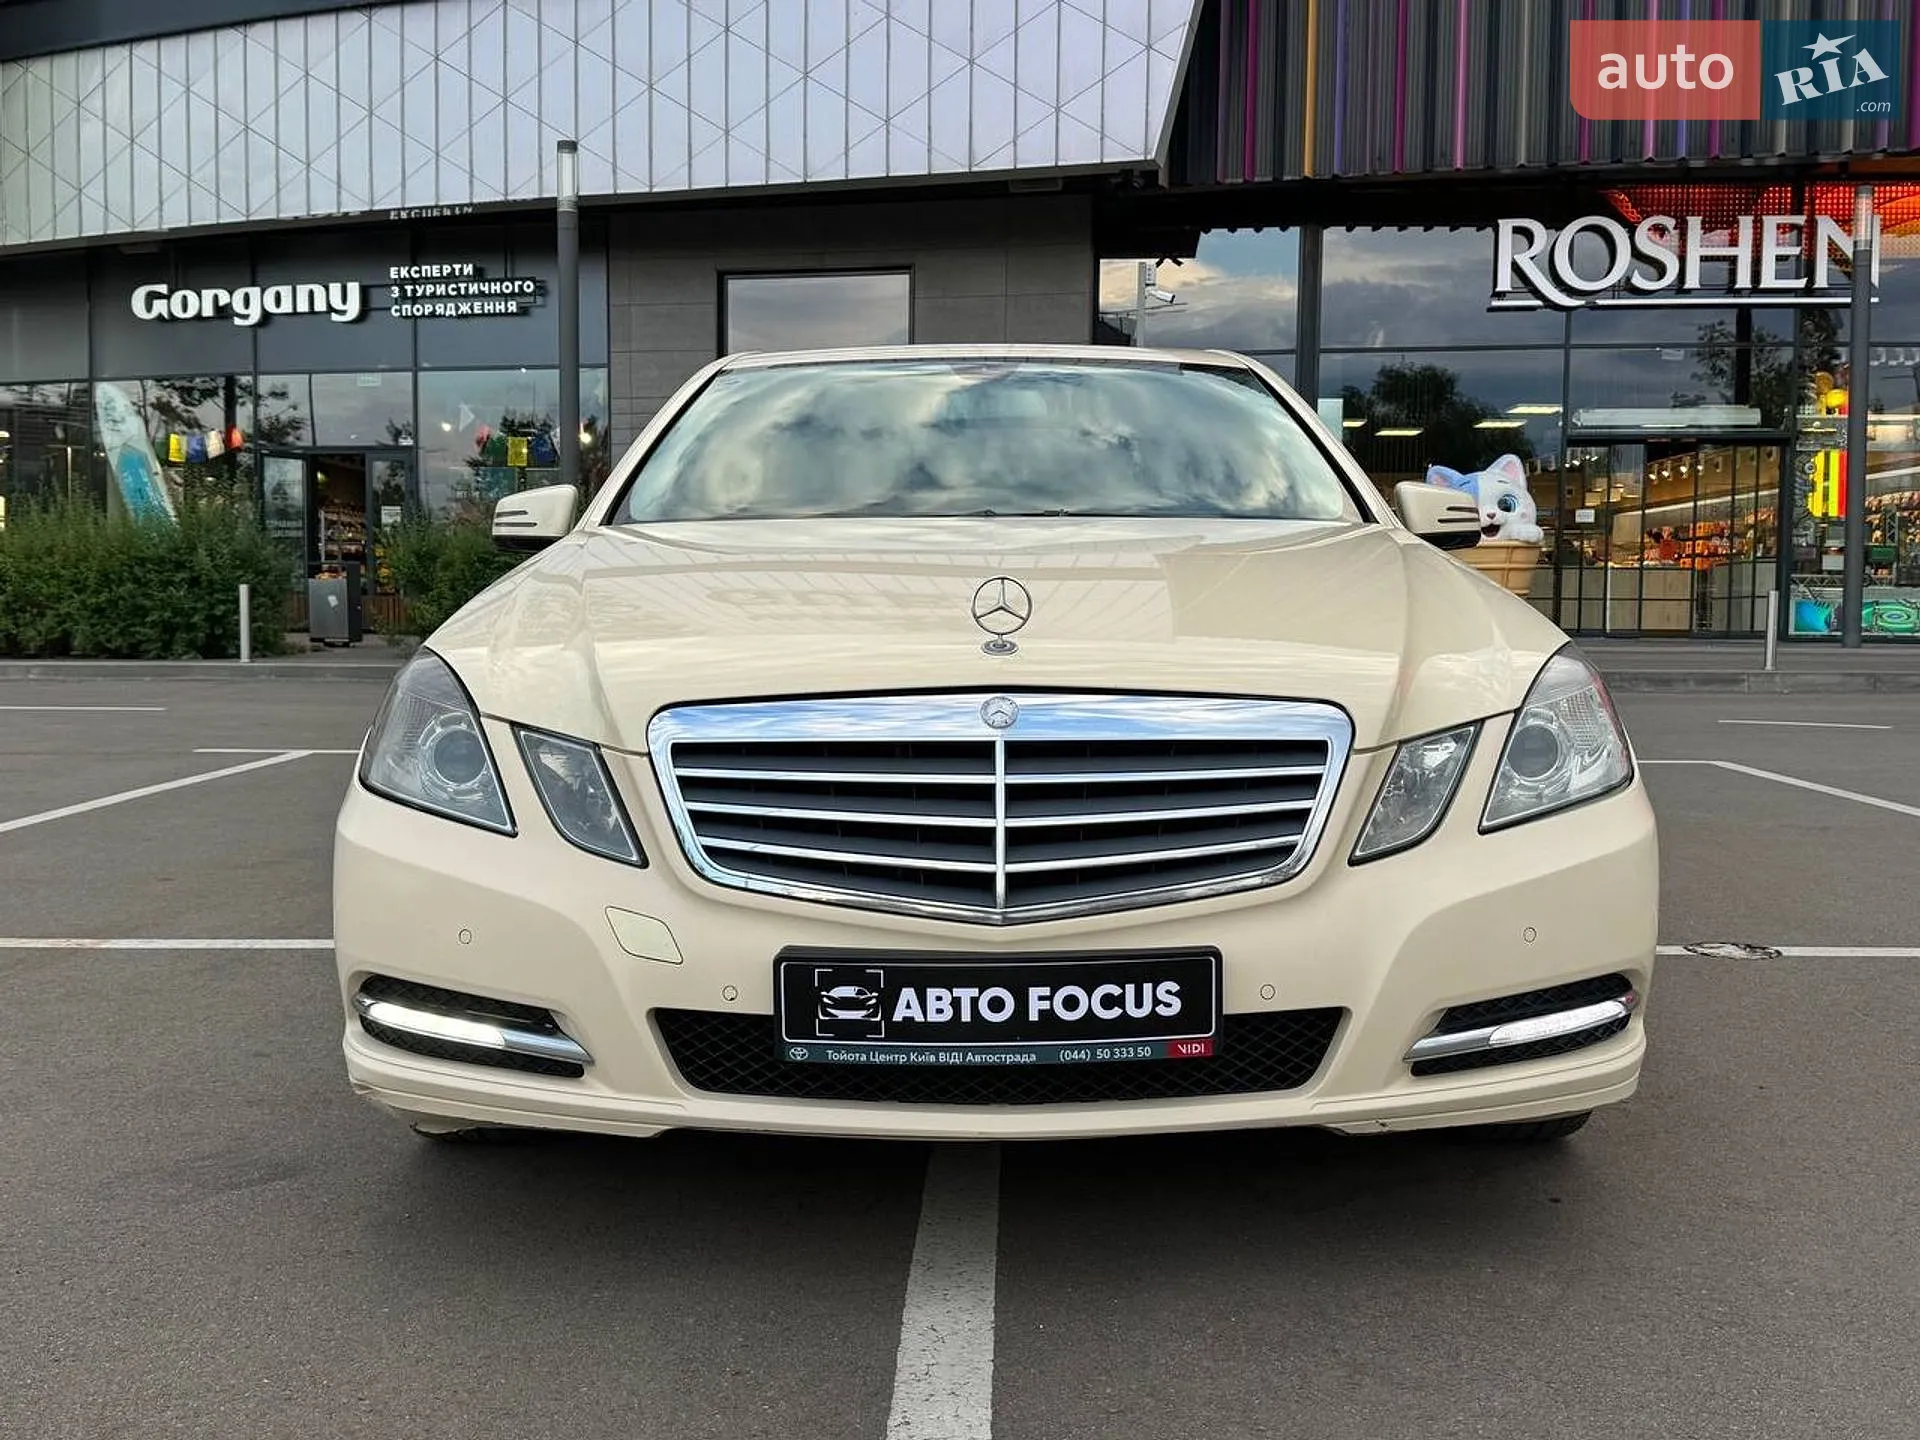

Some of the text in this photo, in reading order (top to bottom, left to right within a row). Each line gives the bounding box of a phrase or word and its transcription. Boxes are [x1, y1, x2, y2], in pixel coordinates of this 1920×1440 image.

[1491, 214, 1880, 307] ROSHEN
[389, 263, 474, 279] ЕКСПЕРТИ
[404, 280, 535, 298] ТУРИСТИЧНОГО
[130, 281, 361, 327] Gorgany
[391, 301, 518, 317] СПОРЯДЖЕННЯ
[1028, 980, 1182, 1022] FOCUS
[826, 1049, 867, 1062] Тойота
[869, 1051, 908, 1065] Центр
[910, 1051, 937, 1063] Київ
[965, 1050, 1037, 1065] Автострада
[1059, 1046, 1152, 1062] (044) 50 333 50
[1177, 1043, 1206, 1055] VIDI
